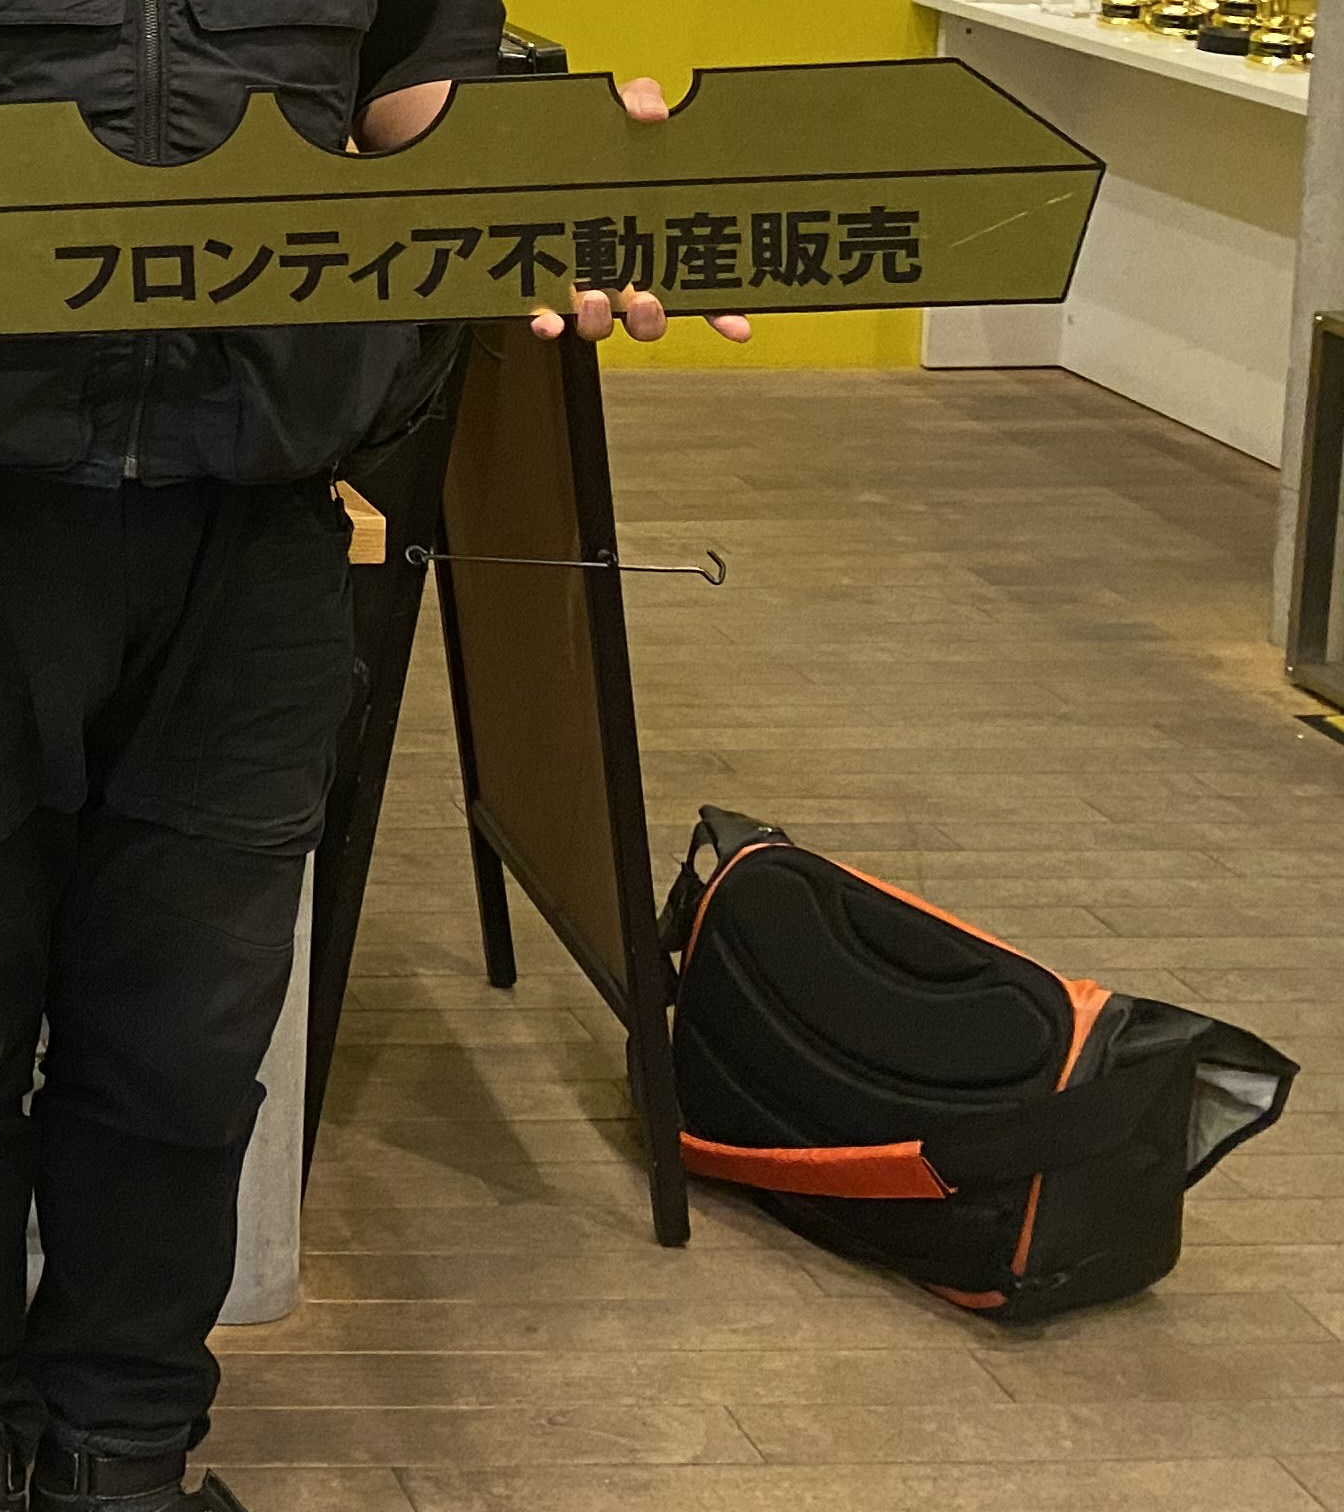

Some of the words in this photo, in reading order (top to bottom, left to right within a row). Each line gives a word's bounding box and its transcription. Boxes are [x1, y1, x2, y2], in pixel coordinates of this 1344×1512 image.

[54, 206, 923, 311] フロンティア不動産販売
